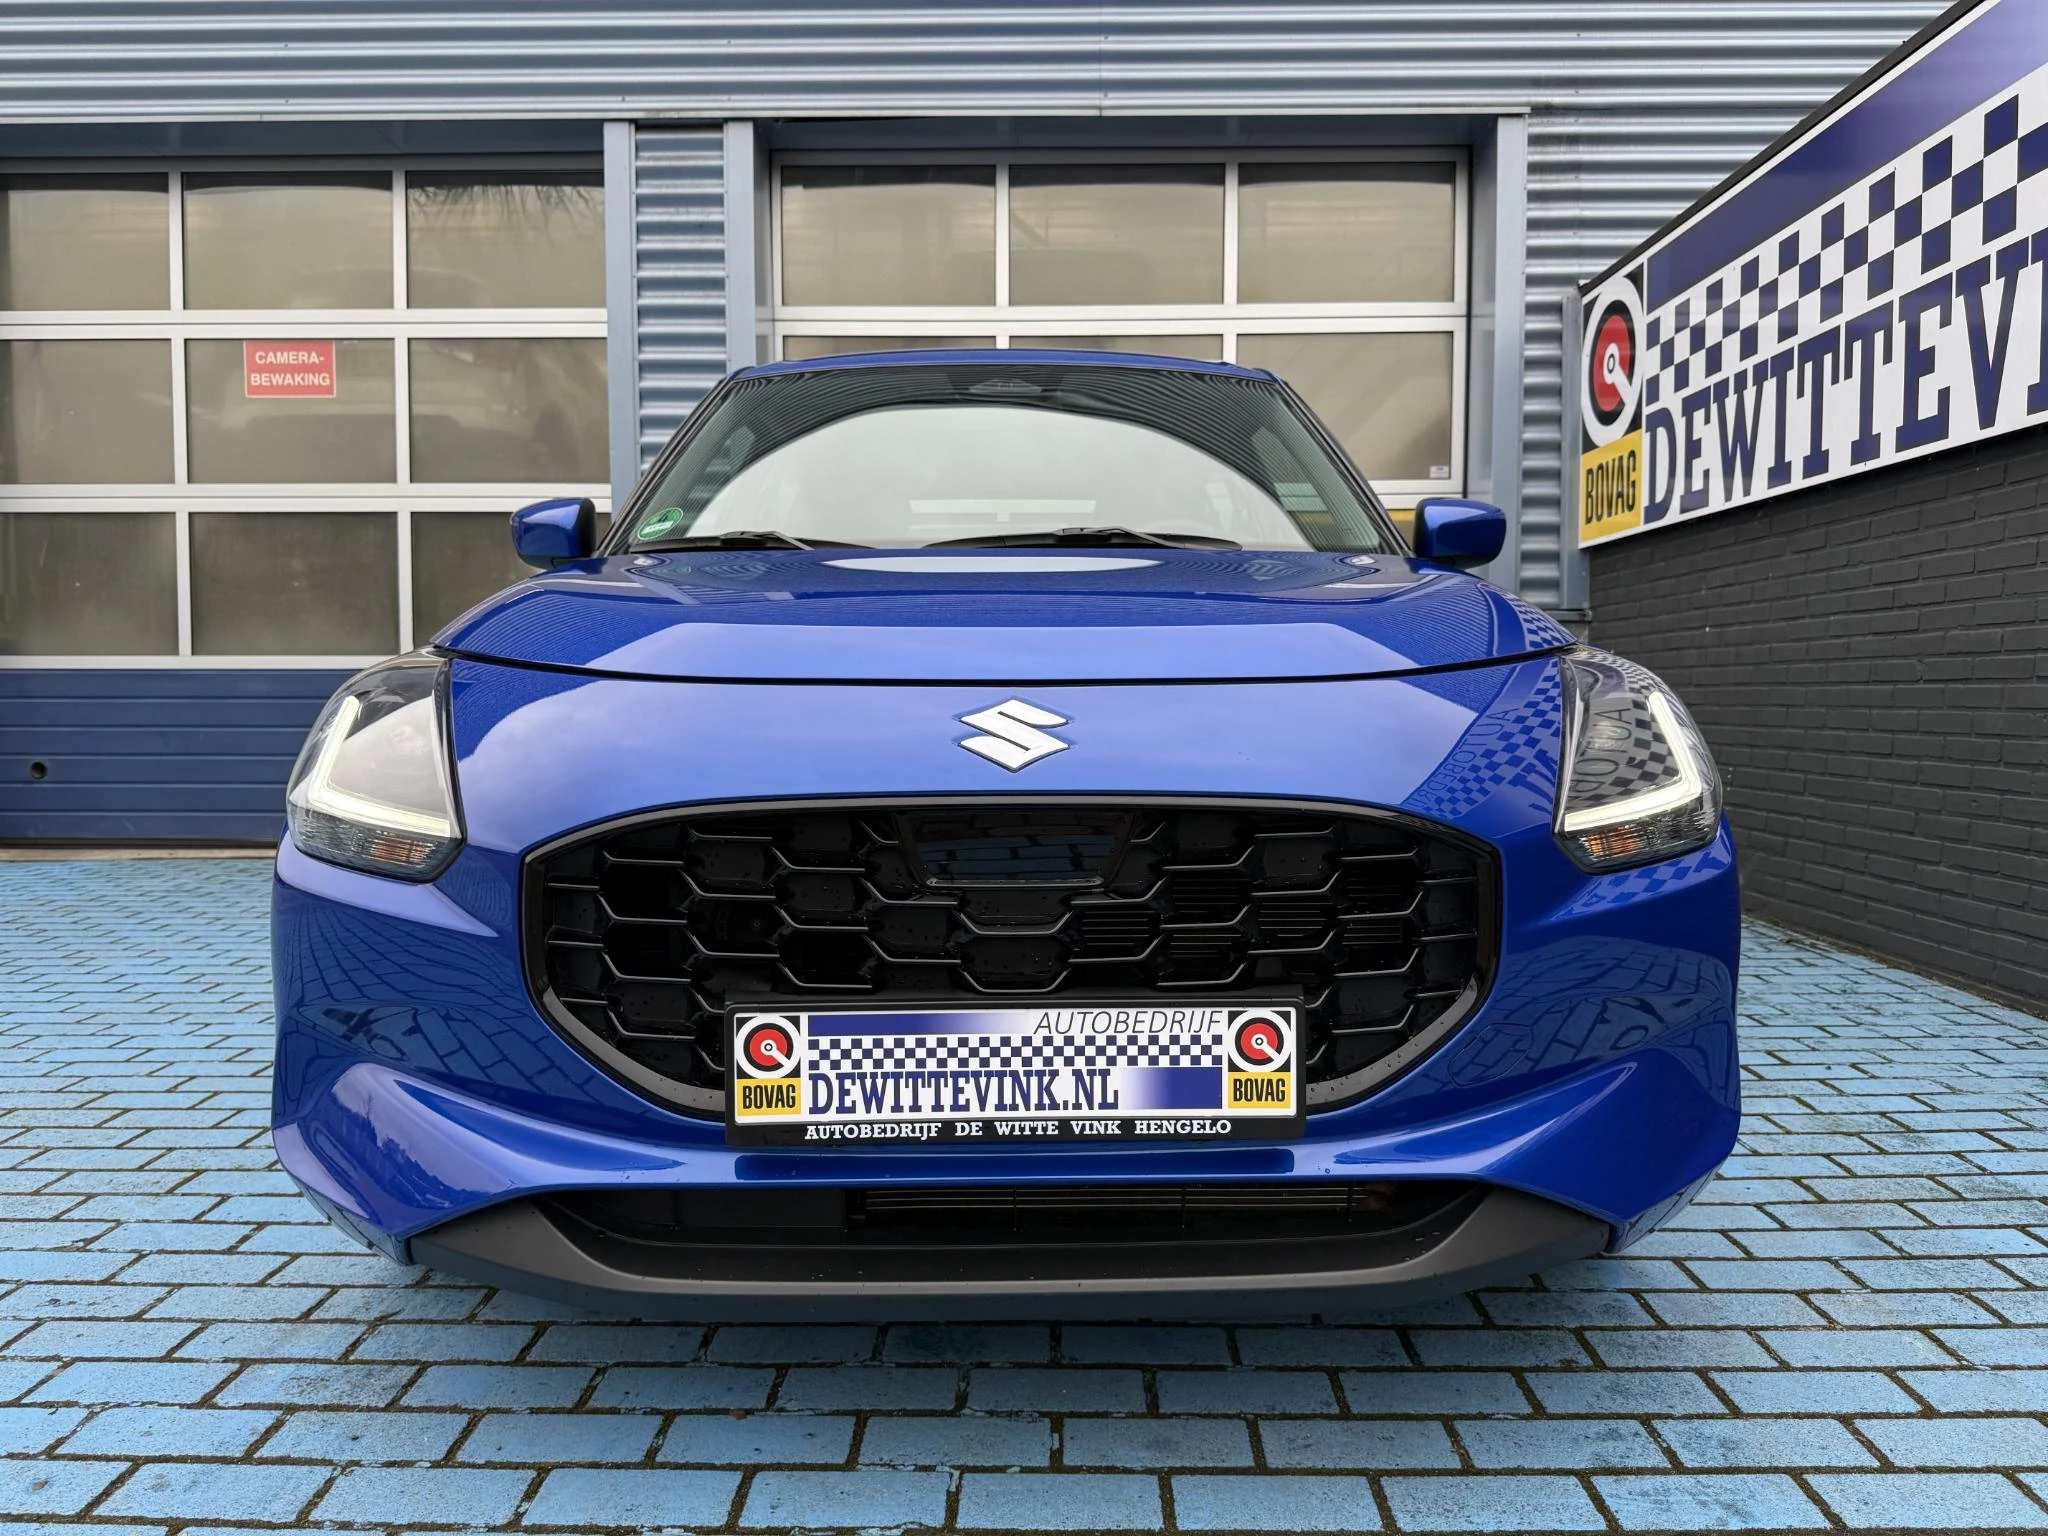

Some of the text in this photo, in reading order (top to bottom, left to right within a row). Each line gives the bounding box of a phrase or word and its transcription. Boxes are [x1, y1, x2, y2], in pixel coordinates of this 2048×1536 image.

[255, 351, 325, 364] CAMERA-
[250, 373, 330, 386] BEWAKING
[1585, 449, 1637, 525] BOVAG
[1033, 1010, 1223, 1035] AUTOBEDRIJF
[742, 1083, 796, 1110] BOVAG
[808, 1068, 1119, 1115] DEWITTEVINK.NL
[1232, 1077, 1286, 1103] BOVAG
[804, 1119, 1232, 1140] AUTOBEDRIJF DE WITTE VINK HENGELO
